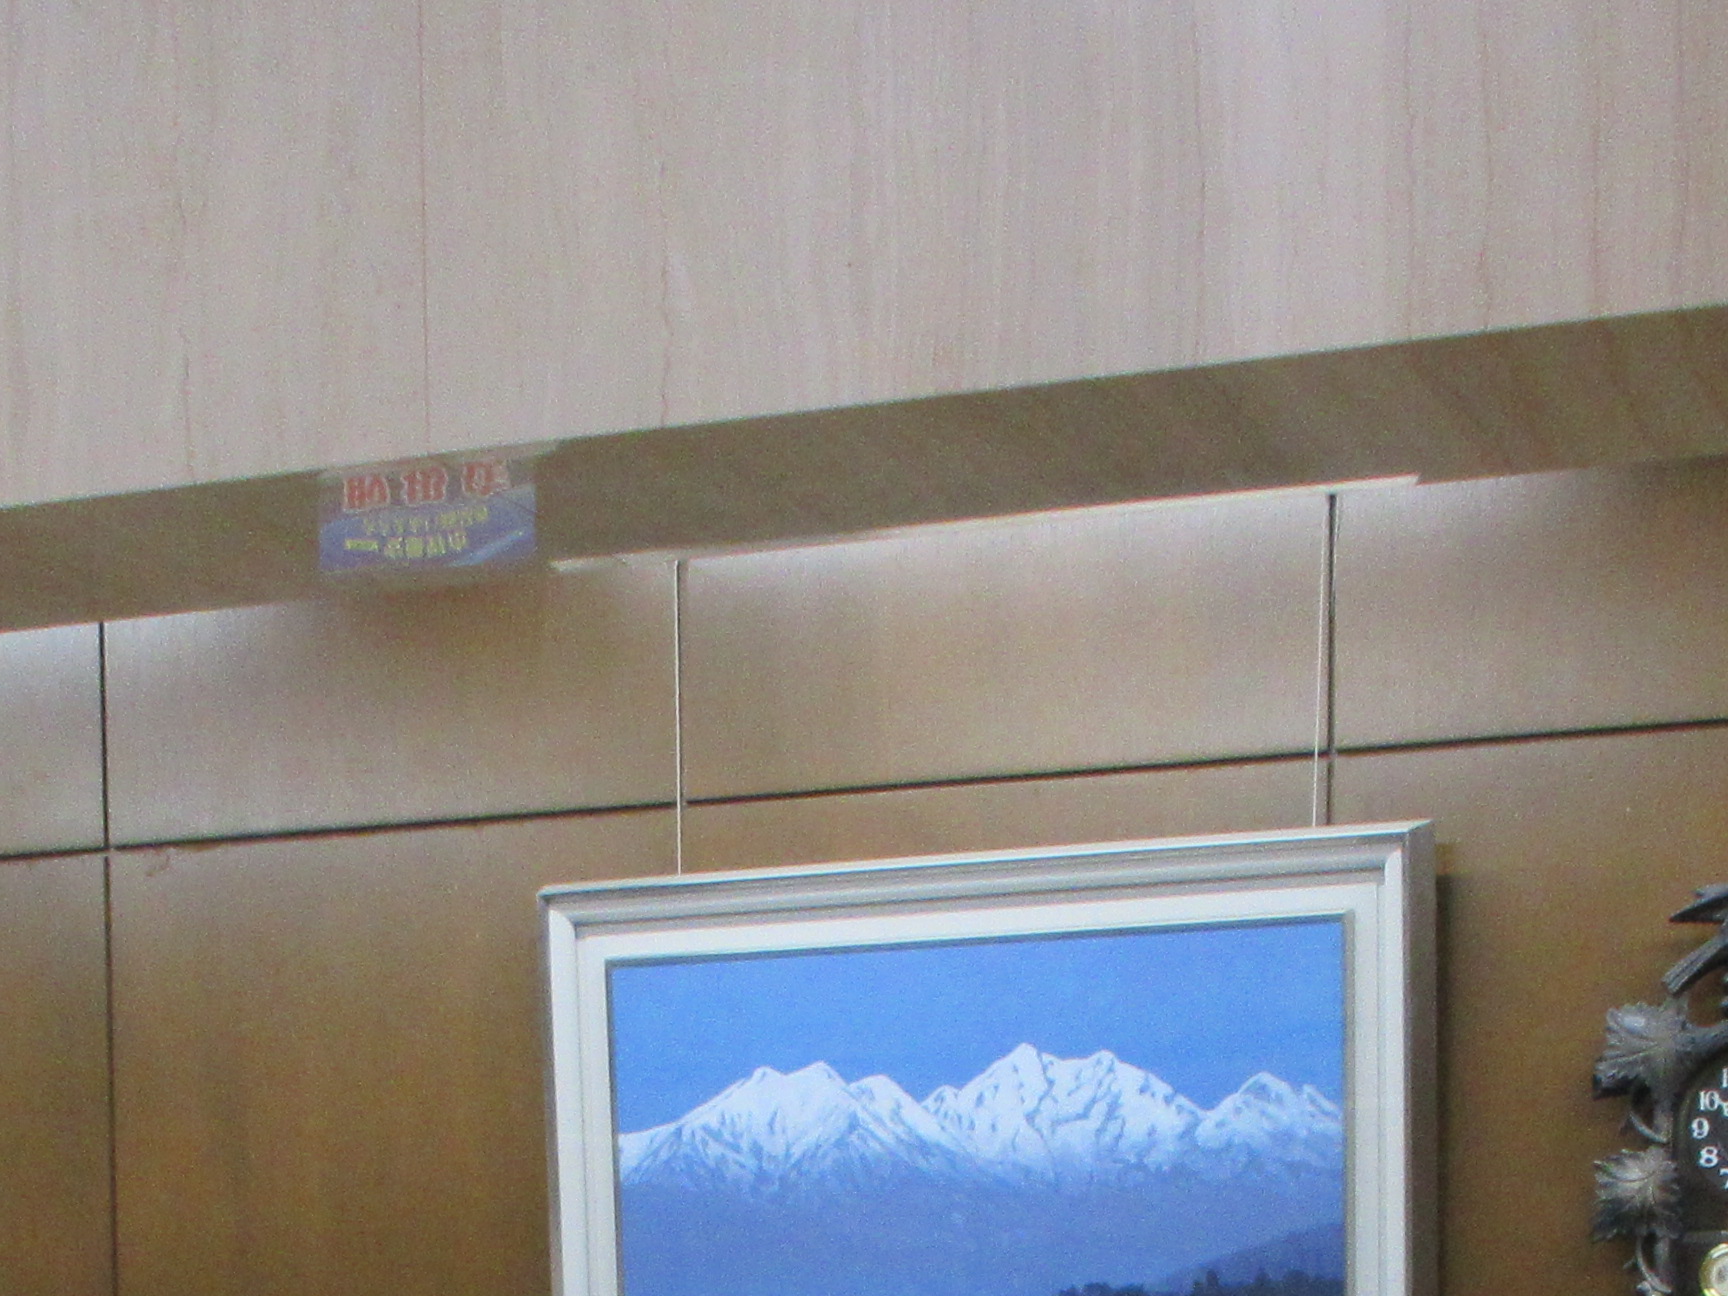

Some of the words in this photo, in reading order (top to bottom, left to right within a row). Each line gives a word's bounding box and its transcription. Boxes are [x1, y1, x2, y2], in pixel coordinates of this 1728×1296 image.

[1699, 1090, 1719, 1111] 10
[1691, 1117, 1710, 1139] 9
[1699, 1146, 1718, 1168] 8
